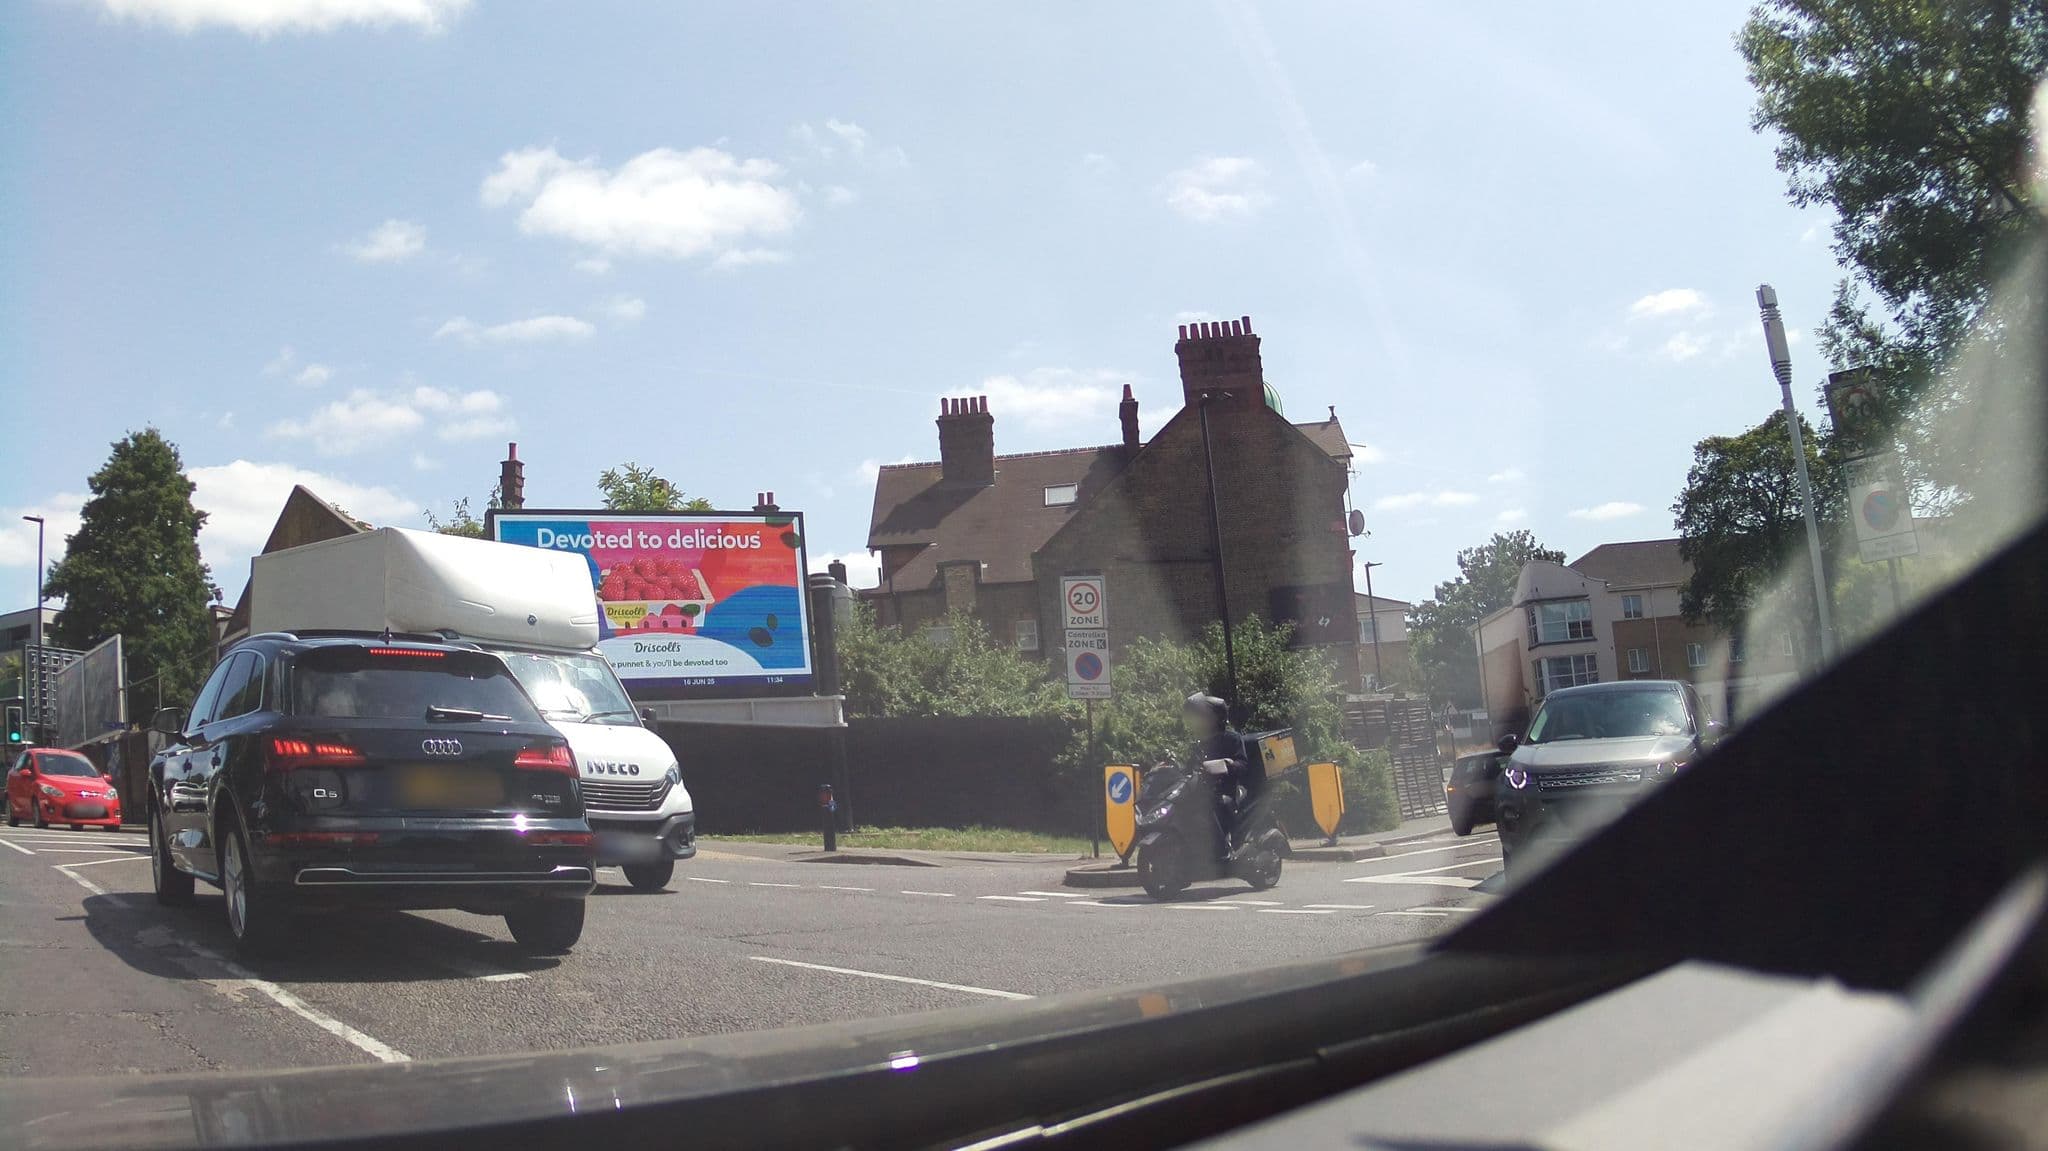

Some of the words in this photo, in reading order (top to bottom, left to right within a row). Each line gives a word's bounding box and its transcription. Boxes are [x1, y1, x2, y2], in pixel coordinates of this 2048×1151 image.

[537, 528, 633, 549] Devoted
[637, 530, 662, 549] to
[667, 528, 762, 549] delicious
[1073, 592, 1095, 605] 20
[1070, 616, 1099, 625] ZONE
[634, 642, 681, 653] Driscoll's
[1069, 640, 1095, 648] ZONE
[617, 661, 644, 669] punnet
[684, 659, 714, 667] devoted
[587, 760, 640, 776] IVECO
[314, 789, 338, 798] Q5
